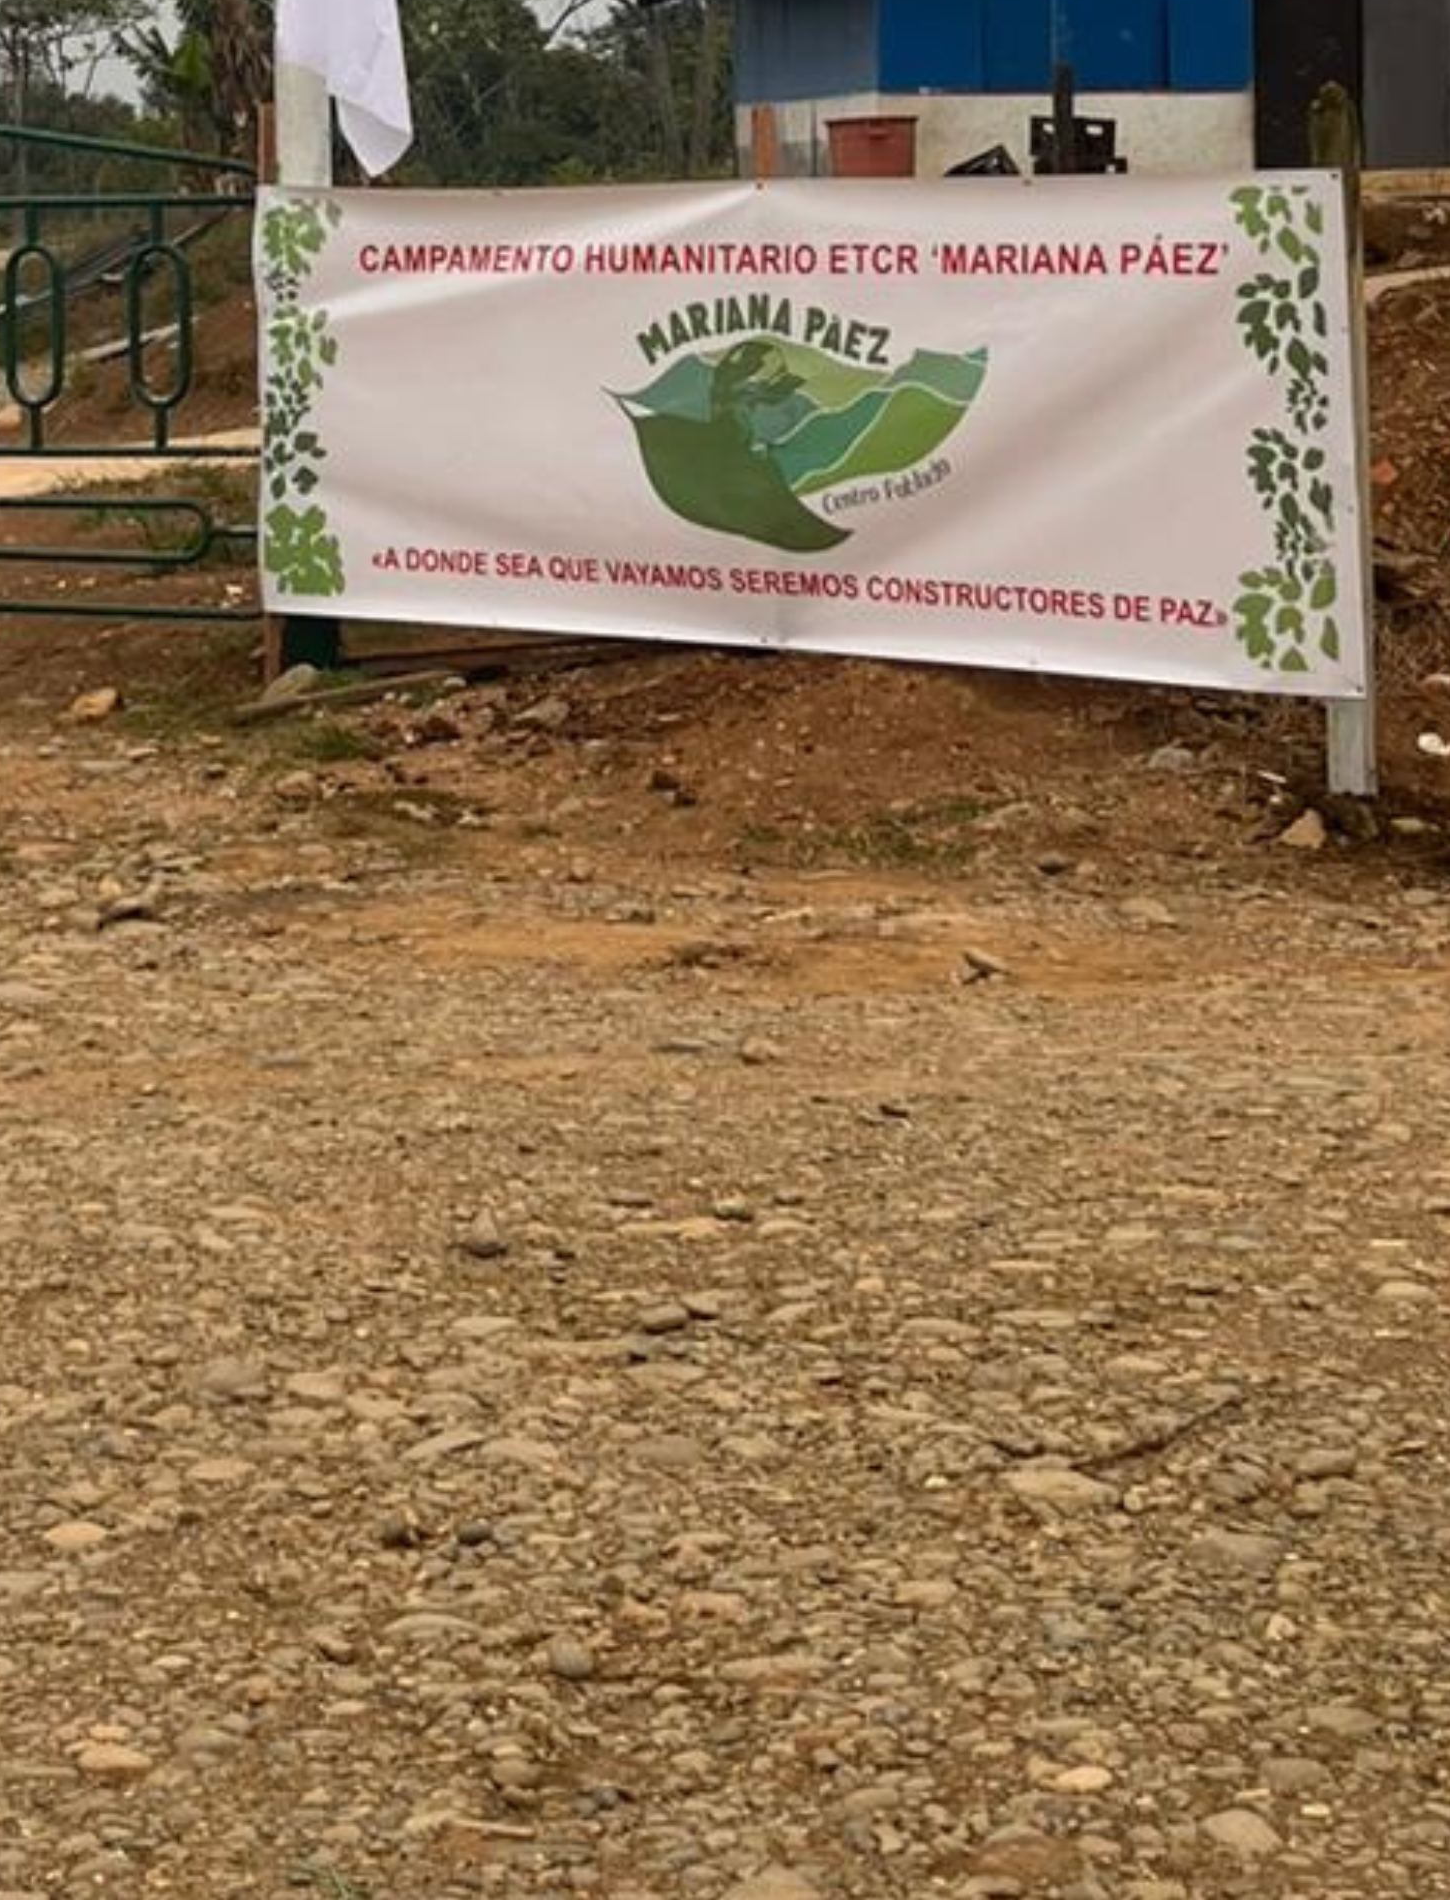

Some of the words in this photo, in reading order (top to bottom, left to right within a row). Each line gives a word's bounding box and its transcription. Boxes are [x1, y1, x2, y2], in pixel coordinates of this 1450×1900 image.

[358, 243, 575, 274] CAMPAMENTO
[585, 243, 819, 275] HUMANITARIO
[827, 243, 919, 274] ETCR
[636, 293, 792, 366] MARIANA
[822, 488, 880, 515] Centro
[405, 548, 488, 575] DONDE
[495, 553, 545, 579] SEA
[549, 557, 599, 583] QUE
[604, 560, 722, 592] VAYAMOS
[728, 569, 860, 599] SEREMOS
[867, 577, 1104, 619] CONSTRUCTORES
[1113, 594, 1150, 623] DE
